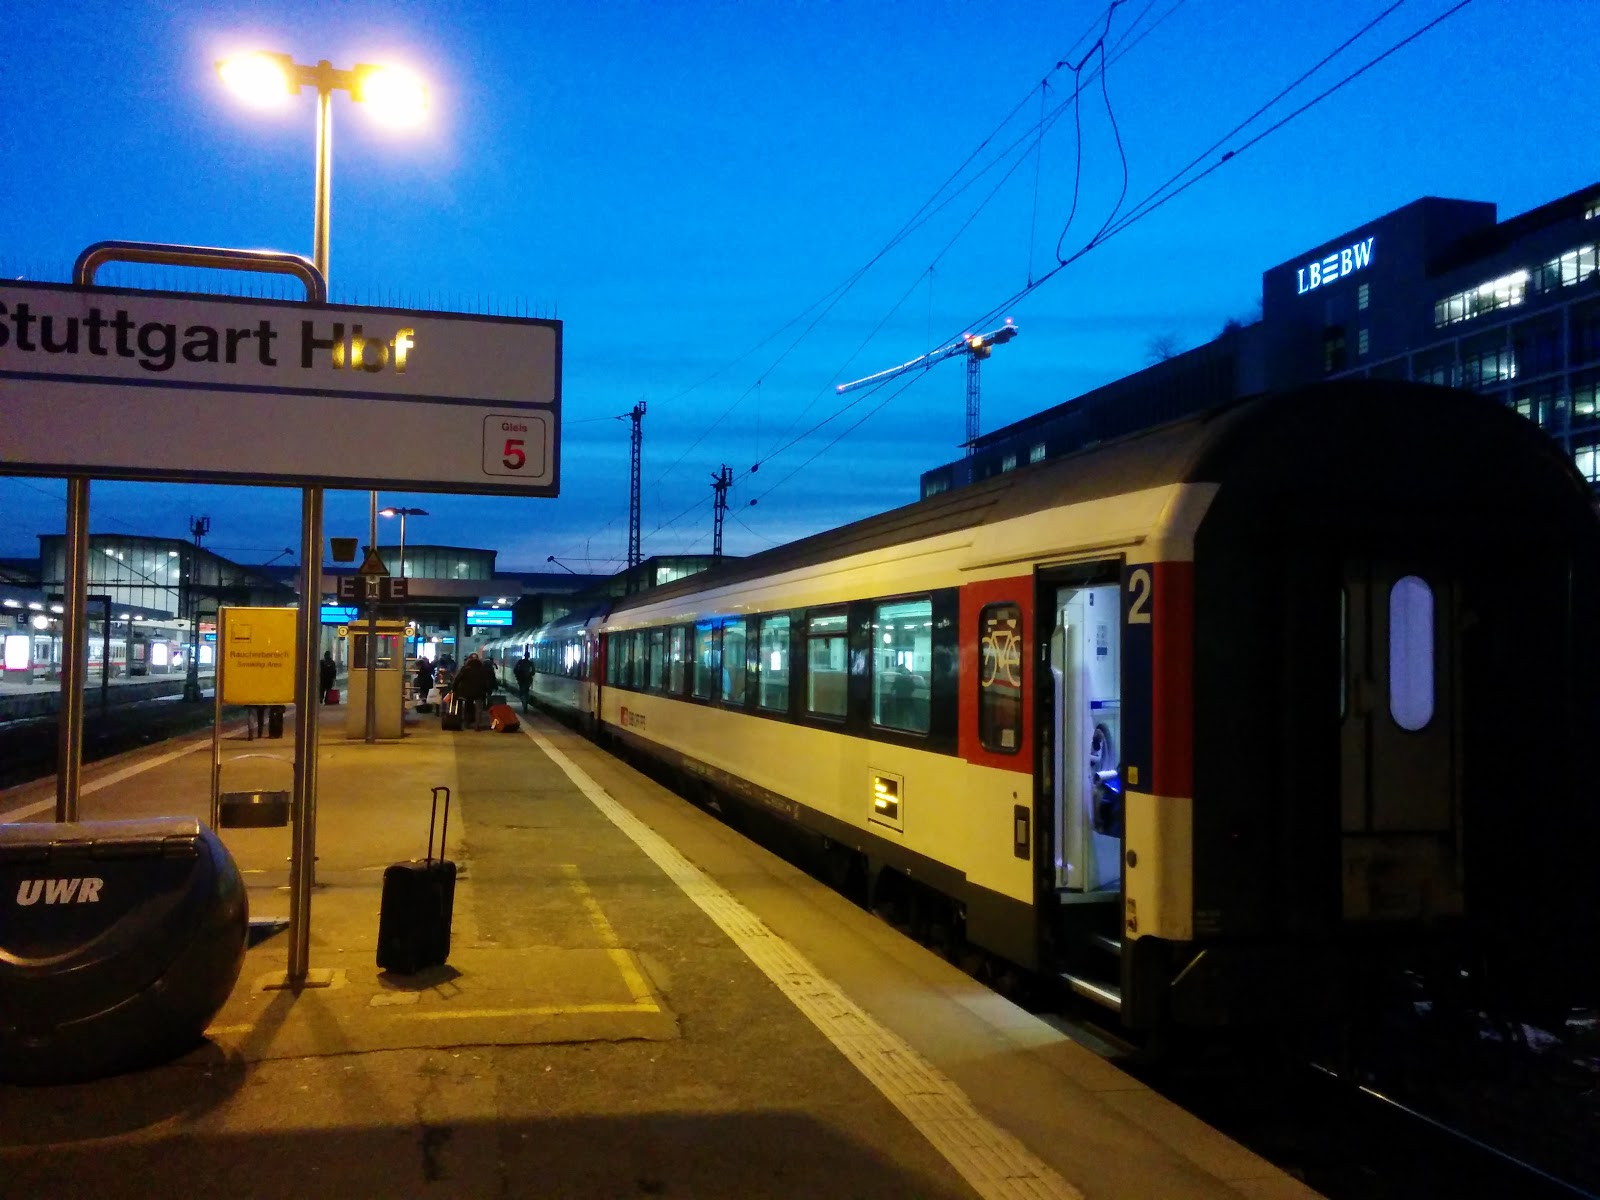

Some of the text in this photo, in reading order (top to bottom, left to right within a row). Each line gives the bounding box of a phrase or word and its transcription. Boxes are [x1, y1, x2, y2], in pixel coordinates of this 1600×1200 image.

[301, 320, 415, 374] Hbf
[501, 422, 528, 433] Gleis
[502, 438, 526, 470] 5
[340, 577, 355, 597] E
[390, 577, 404, 598] E
[1128, 568, 1151, 624] 2
[16, 877, 104, 906] UWR
